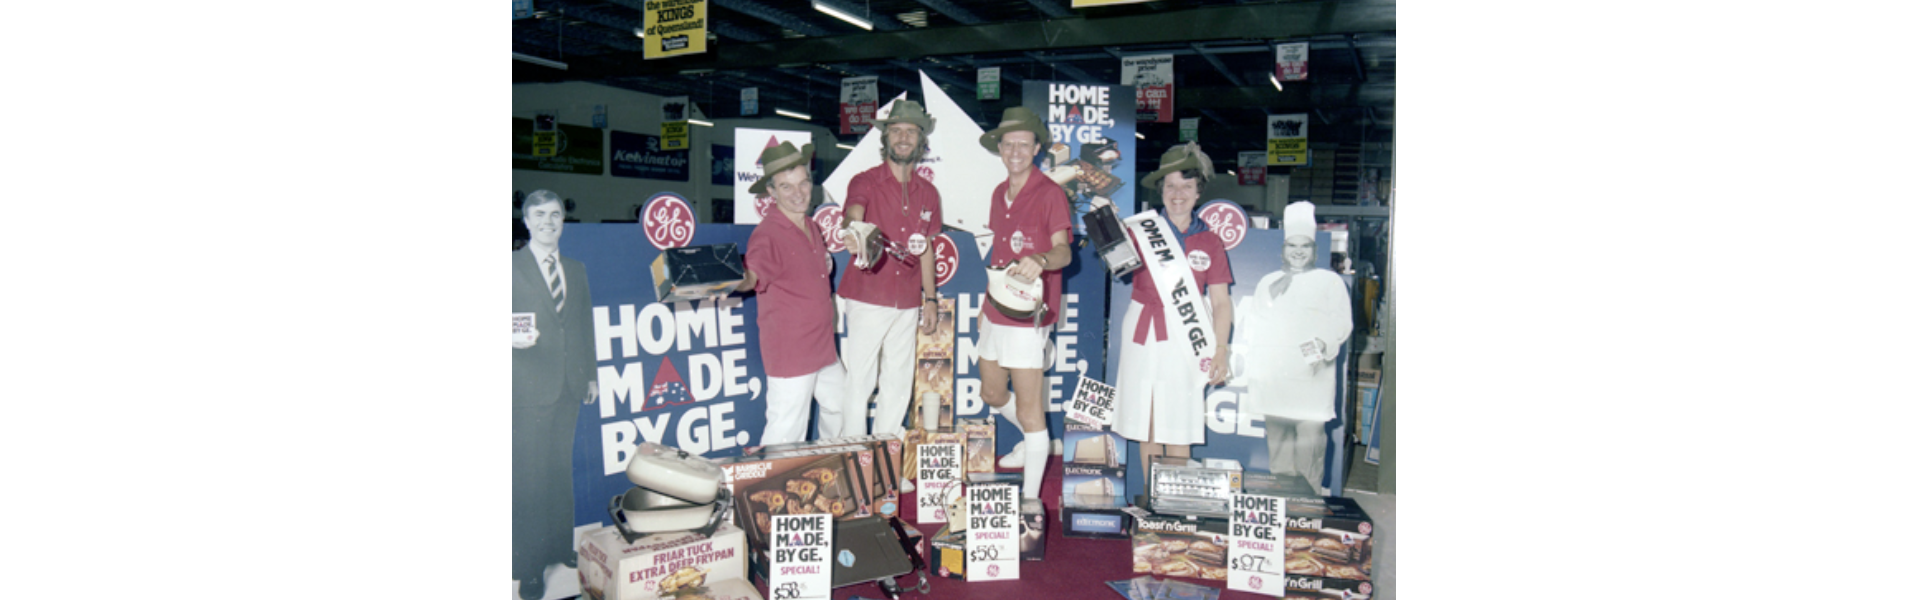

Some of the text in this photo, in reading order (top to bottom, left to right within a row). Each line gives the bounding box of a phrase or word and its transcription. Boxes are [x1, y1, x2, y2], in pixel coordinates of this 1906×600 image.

[657, 5, 694, 23] KINGS
[646, 18, 703, 36] of Queensland!
[1048, 83, 1110, 105] HOME
[1145, 88, 1167, 98] can
[859, 105, 874, 113] can
[1048, 104, 1115, 129] MADE,
[849, 113, 860, 123] do
[1048, 124, 1108, 145] BY GE.
[614, 150, 687, 168] Kelvinator
[1177, 301, 1200, 325] BY
[592, 297, 746, 362] HOME
[1188, 326, 1208, 357] GE.
[597, 348, 762, 418] MADE,
[1081, 378, 1116, 400] HOME
[1073, 400, 1106, 421] BY GE.
[601, 401, 750, 476] BY GE.
[920, 445, 956, 457] HOME
[920, 457, 959, 468] MADE,
[920, 469, 956, 480] BY GE.
[924, 481, 954, 489] SPECIAL!
[970, 487, 1012, 501] HOME
[970, 502, 1017, 516] MADE,
[1234, 495, 1278, 512] HOME
[776, 516, 825, 532] HOME
[970, 515, 1012, 529] BY GE.
[1233, 510, 1282, 528] MADE,
[1297, 518, 1322, 530] Grill
[776, 532, 828, 548] MADE,
[975, 531, 1010, 540] SPECIAL!
[1233, 523, 1276, 541] BY GE.
[653, 547, 686, 566] FRIAR
[687, 541, 713, 555] TUCK
[1237, 540, 1274, 552] SPECIAL!
[776, 547, 823, 563] BY GE.
[629, 547, 734, 584] EXTRA DEEP FRYPAN
[780, 565, 820, 576] SPECIAL!
[1297, 578, 1322, 590] Grill
